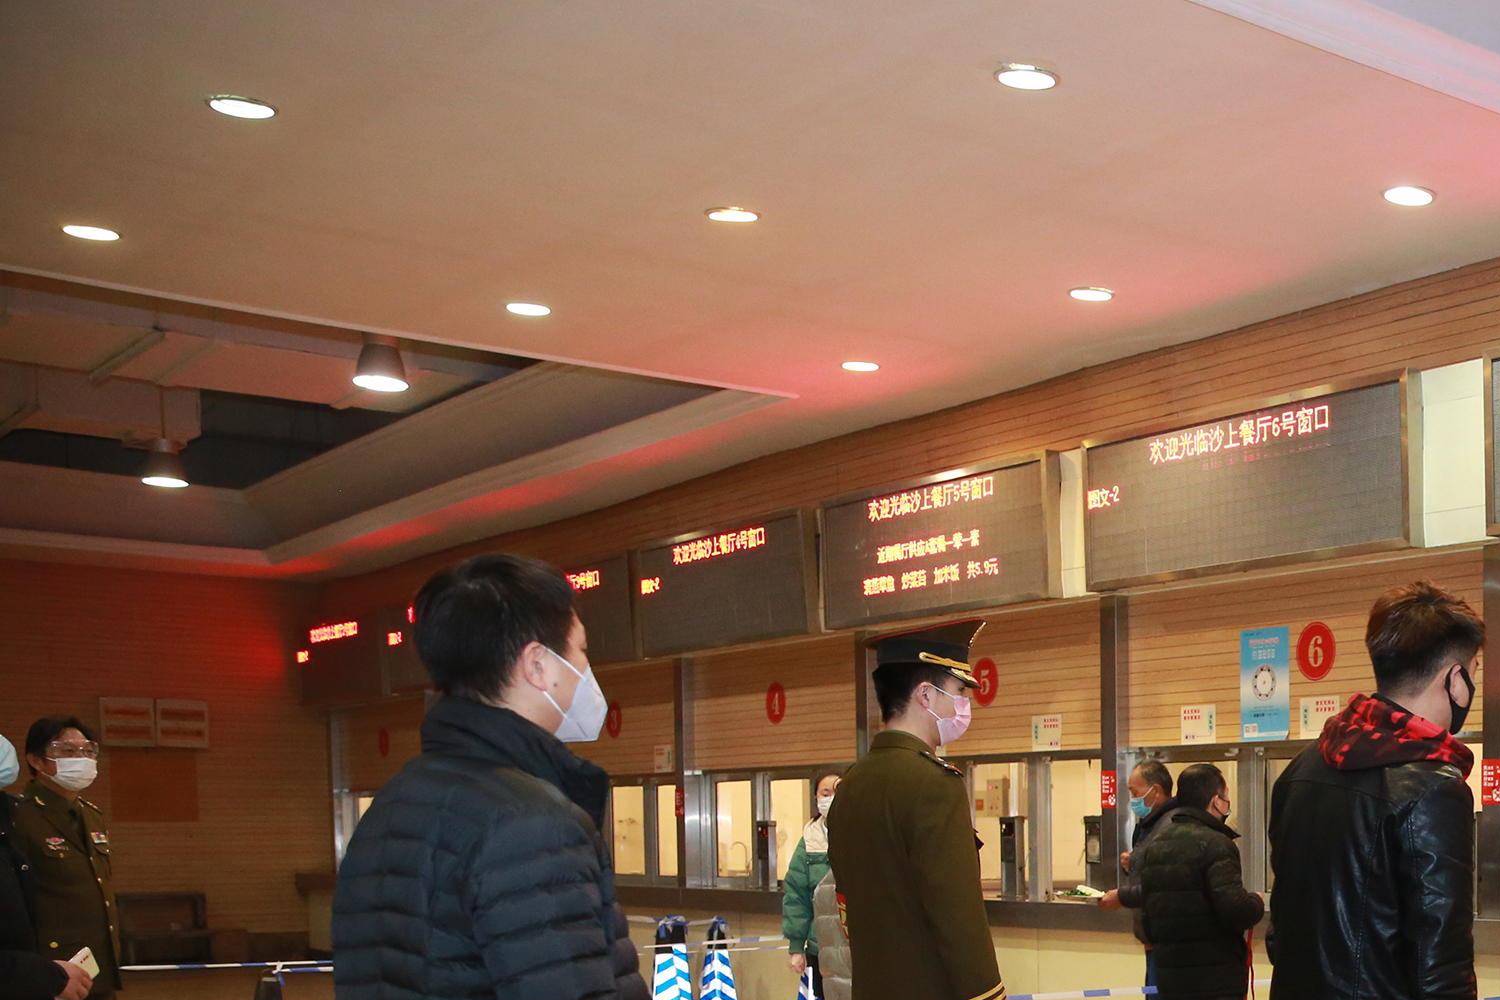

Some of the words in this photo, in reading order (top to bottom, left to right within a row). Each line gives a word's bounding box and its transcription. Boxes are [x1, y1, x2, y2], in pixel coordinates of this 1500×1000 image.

[1148, 404, 1330, 466] 欢迎光临沙上餐厅6号窗口
[868, 475, 994, 523] 欢迎光临沙上餐厅5号窗口
[1086, 485, 1120, 511] 图文-2
[1308, 635, 1324, 667] 6
[980, 669, 991, 696] 5
[771, 690, 781, 717] 4
